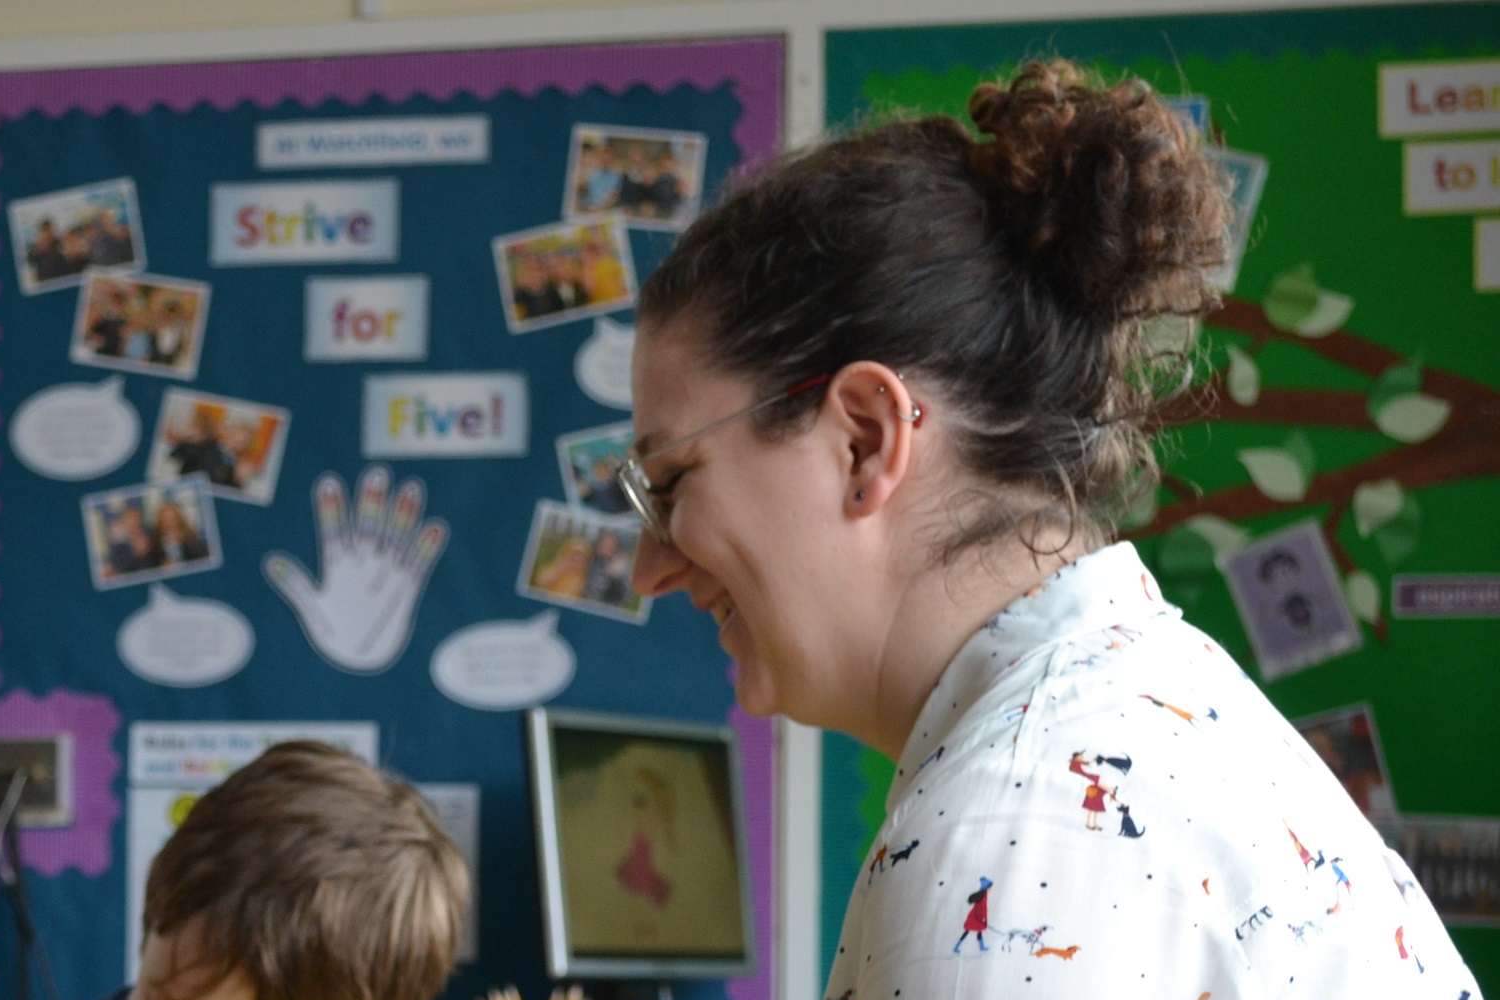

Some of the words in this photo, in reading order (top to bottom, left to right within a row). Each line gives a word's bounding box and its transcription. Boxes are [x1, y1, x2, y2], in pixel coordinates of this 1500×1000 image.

[1434, 156, 1477, 192] to
[234, 202, 374, 248] Strive
[332, 298, 402, 343] for
[387, 393, 504, 440] Five!
